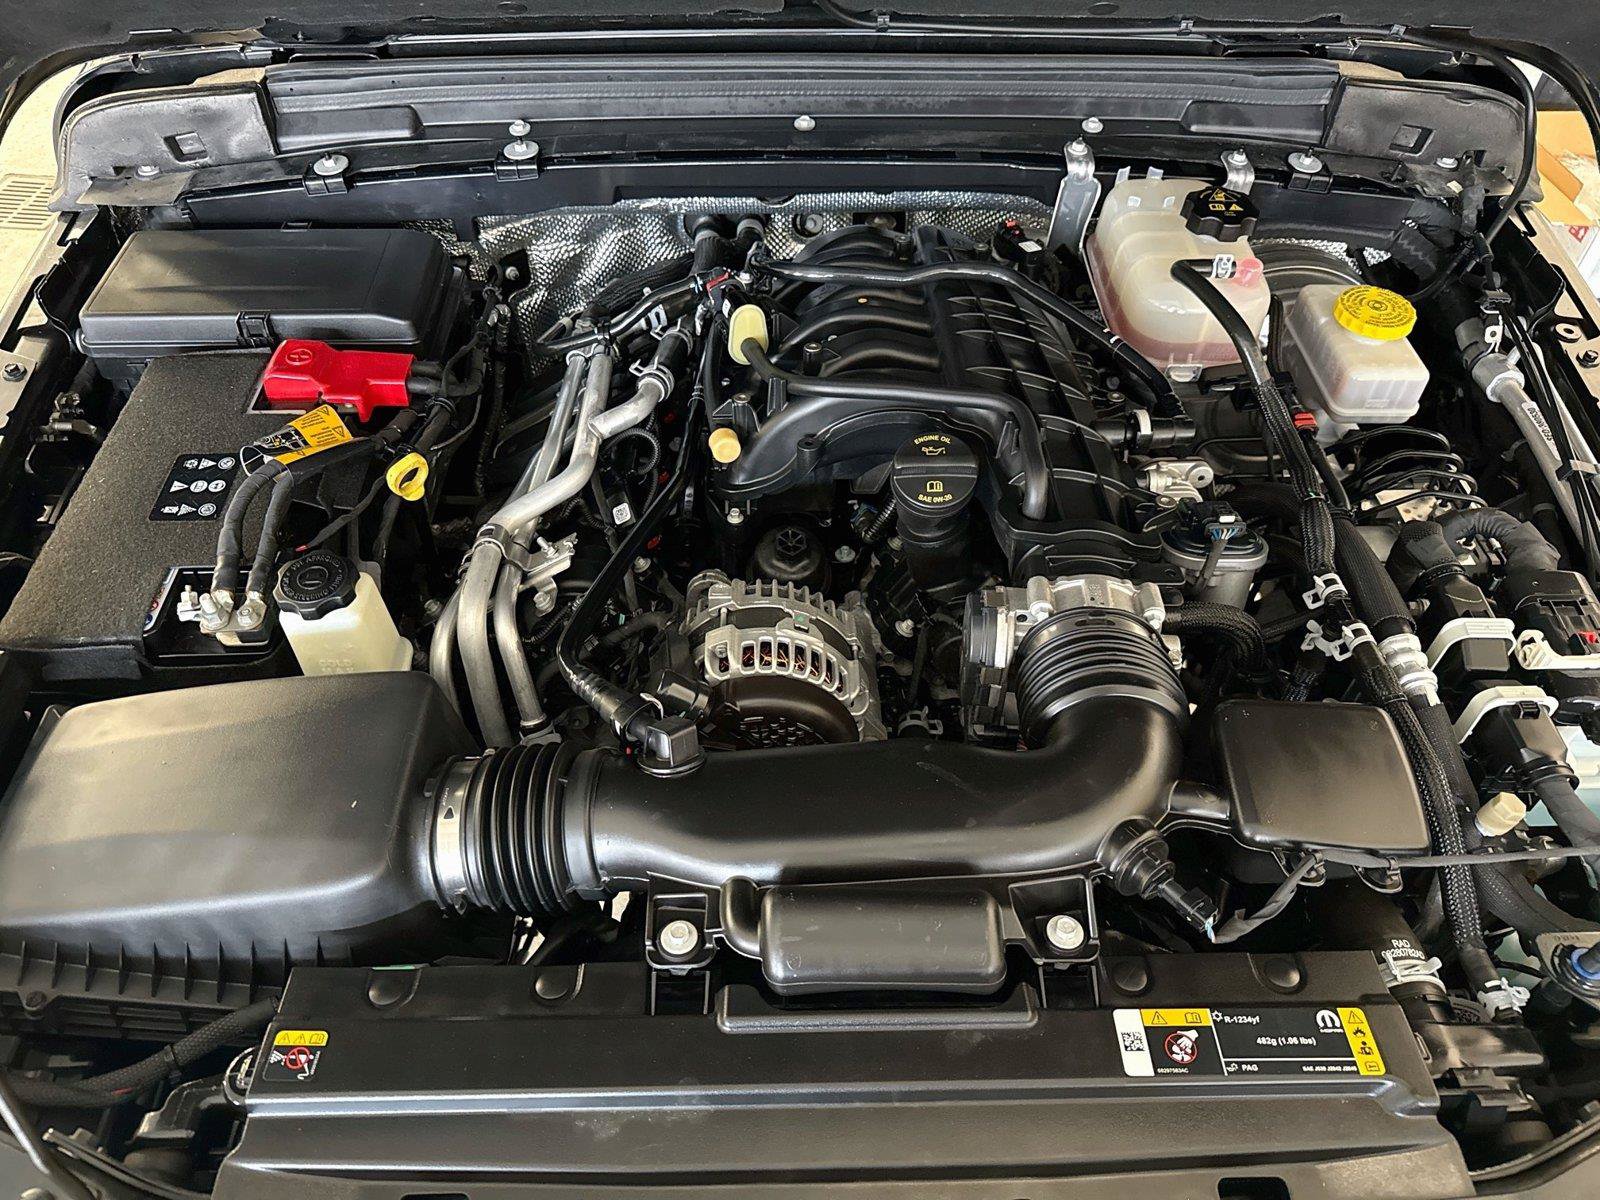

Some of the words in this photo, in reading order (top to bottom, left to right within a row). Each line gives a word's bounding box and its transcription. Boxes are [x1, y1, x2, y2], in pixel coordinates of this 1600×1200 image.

[914, 435, 939, 444] ENGINE
[940, 436, 951, 444] OIL
[918, 494, 931, 503] SAE
[933, 494, 952, 503] 0W-20
[1391, 939, 1411, 948] RAD
[1223, 1015, 1260, 1025] R-1234yf
[1256, 1036, 1278, 1046] 482g
[1278, 1036, 1299, 1046] (1.06
[1299, 1036, 1317, 1046] lbs)
[1241, 1064, 1259, 1072] PAG
